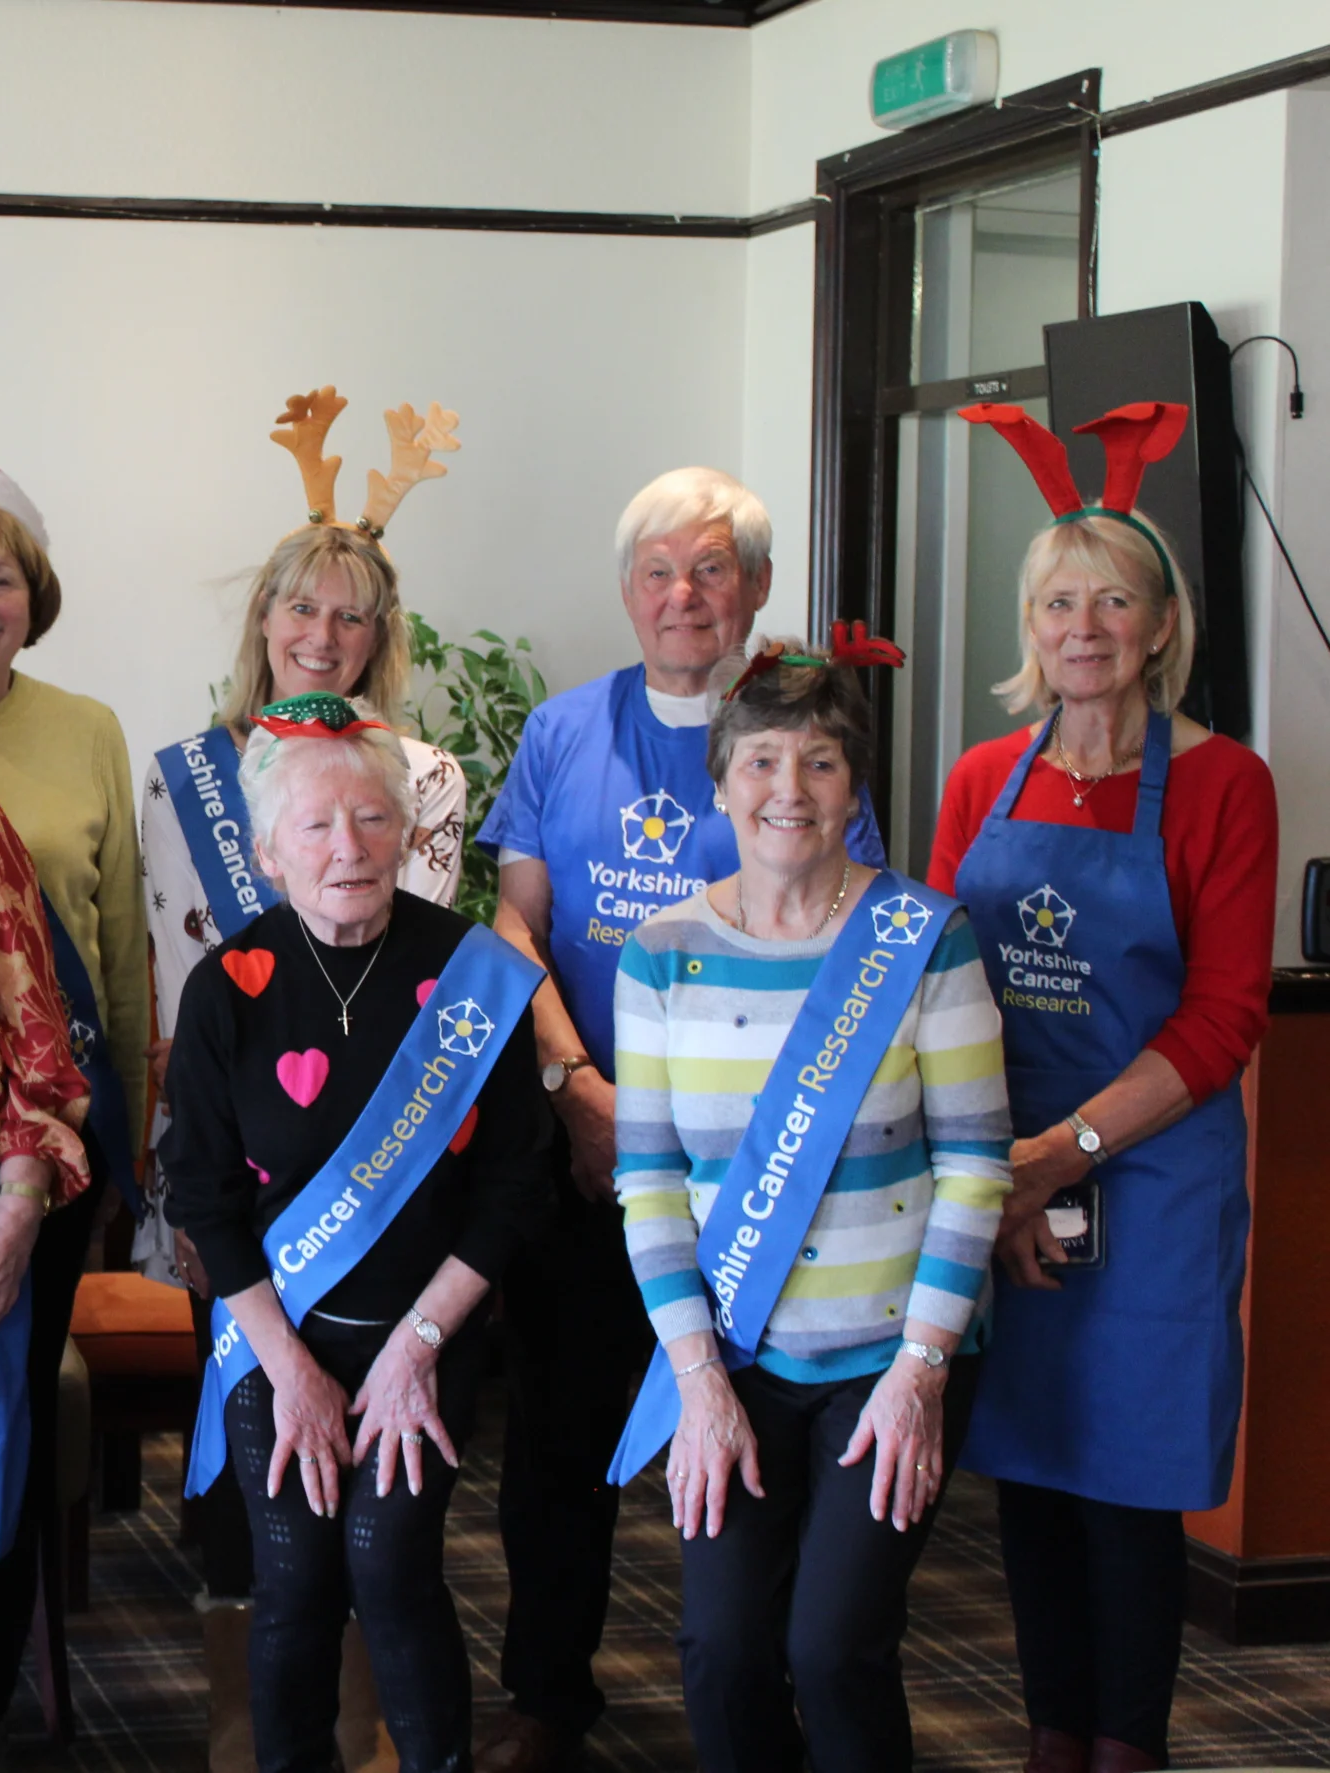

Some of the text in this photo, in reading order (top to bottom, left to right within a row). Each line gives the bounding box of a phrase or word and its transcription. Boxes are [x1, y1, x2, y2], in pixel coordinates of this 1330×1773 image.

[212, 820, 264, 915] Cancer
[587, 860, 708, 897] Yorkshire
[596, 892, 670, 921] Canc
[998, 943, 1092, 976] Yorkshire
[1008, 967, 1082, 993] Cancer
[1003, 987, 1091, 1016] Research
[742, 1093, 816, 1221] Cancer
[797, 948, 895, 1093] Research
[278, 1186, 362, 1274] Cancer
[350, 1055, 456, 1191] Research
